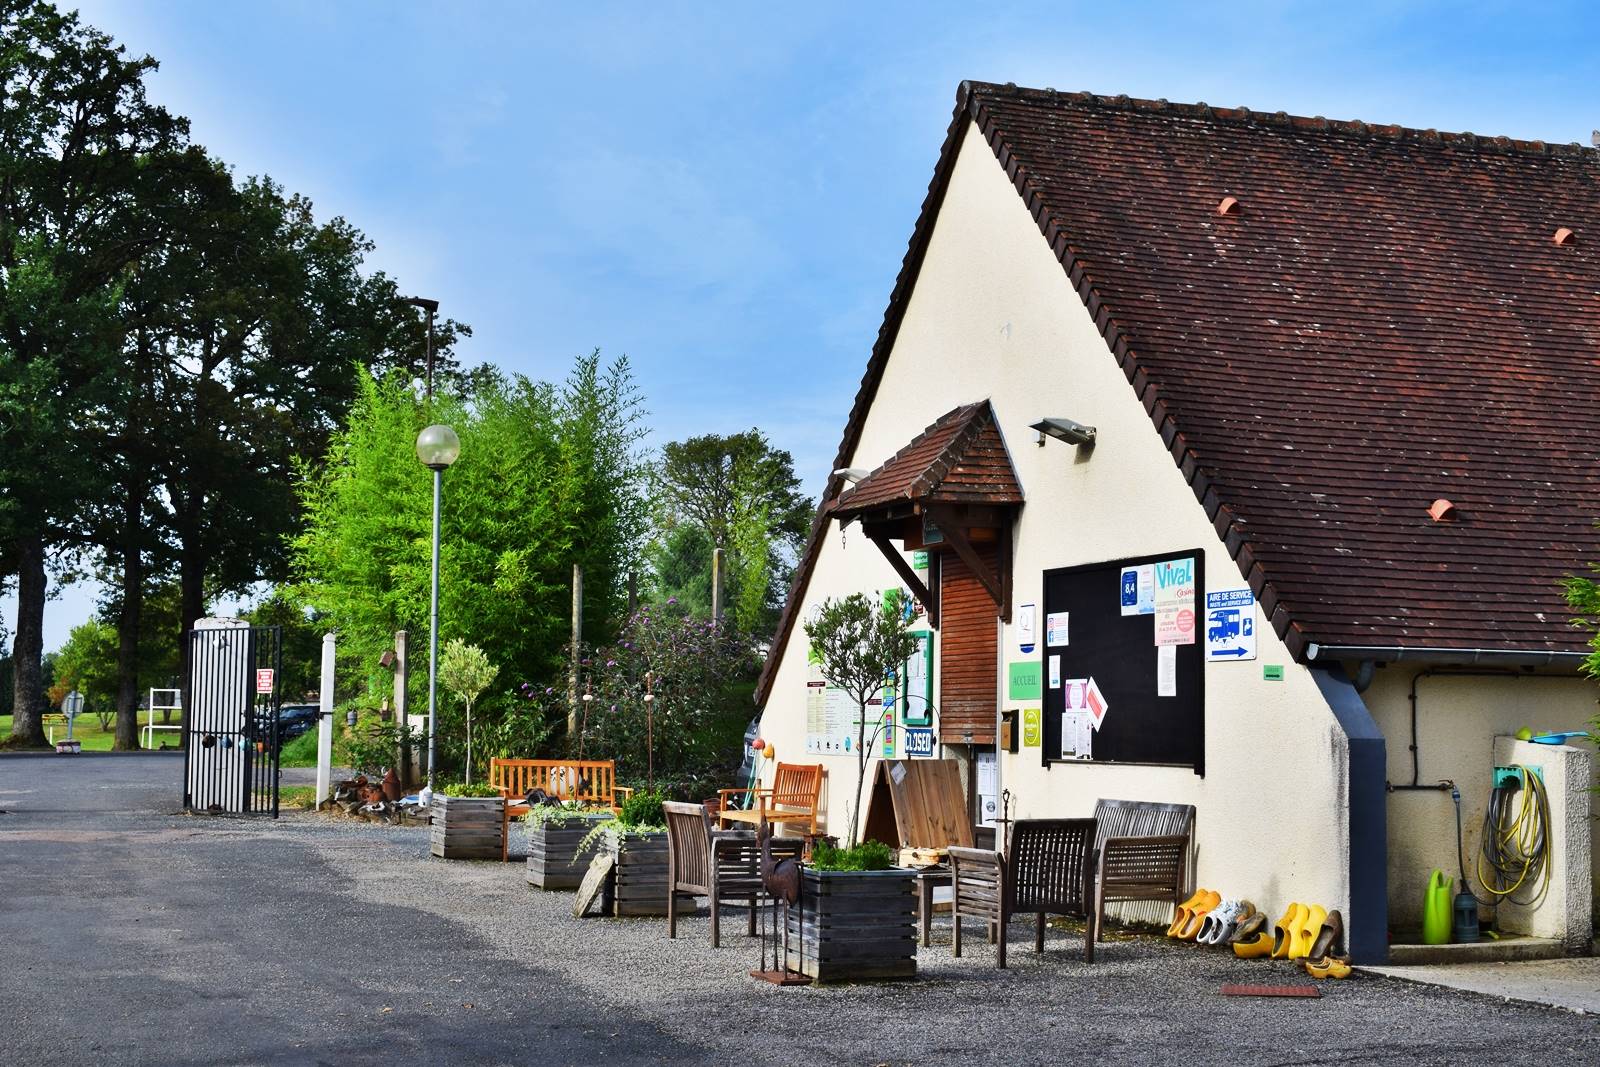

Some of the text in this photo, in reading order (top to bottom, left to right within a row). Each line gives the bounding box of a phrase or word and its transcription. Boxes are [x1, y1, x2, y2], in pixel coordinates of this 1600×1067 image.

[1125, 583, 1135, 595] 8,4
[1209, 590, 1252, 601] AIRE DE SERVICE
[1013, 675, 1036, 687] ACCUEIL
[905, 732, 931, 751] CLOSED
